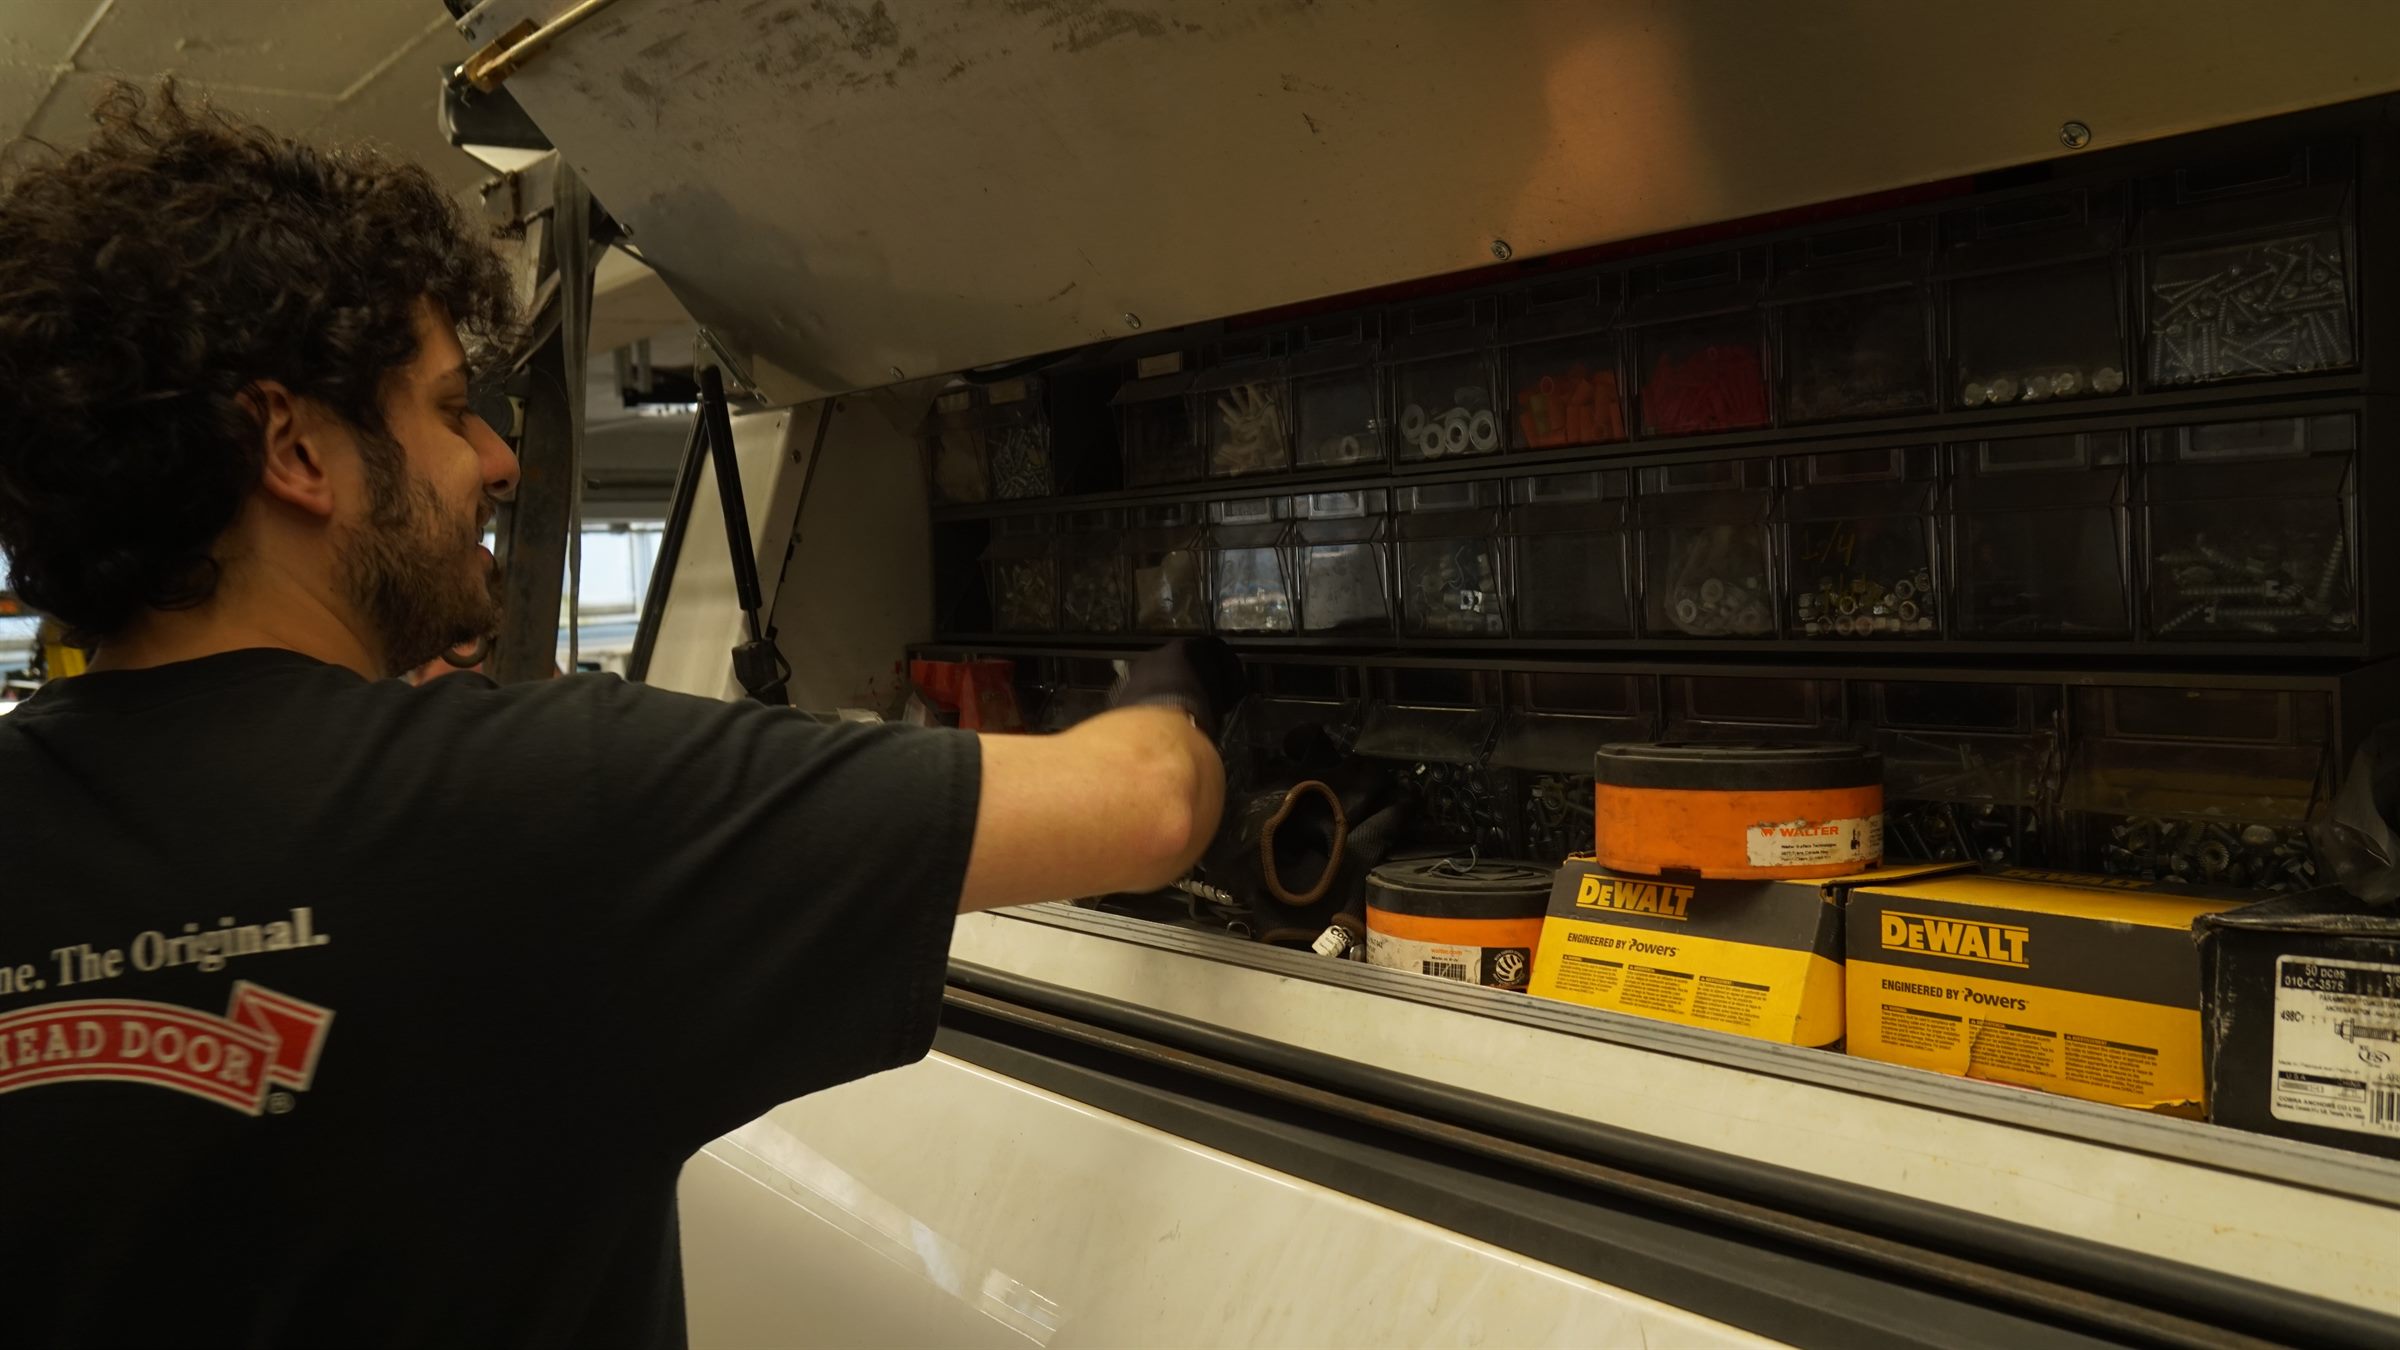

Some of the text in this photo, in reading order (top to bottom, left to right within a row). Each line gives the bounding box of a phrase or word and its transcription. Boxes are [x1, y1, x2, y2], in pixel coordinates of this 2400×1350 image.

[1780, 826, 1839, 837] WALTER
[1577, 877, 1694, 916] DEWALT
[50, 943, 125, 987] The
[130, 907, 331, 973] Original.
[1567, 932, 1677, 957] ENGINEERED BY Powers
[1881, 914, 2029, 963] DEWALT
[2305, 964, 2318, 976] 50
[1881, 979, 2026, 1011] ENGINEERED BY Powers
[118, 1021, 253, 1087] DOOR
